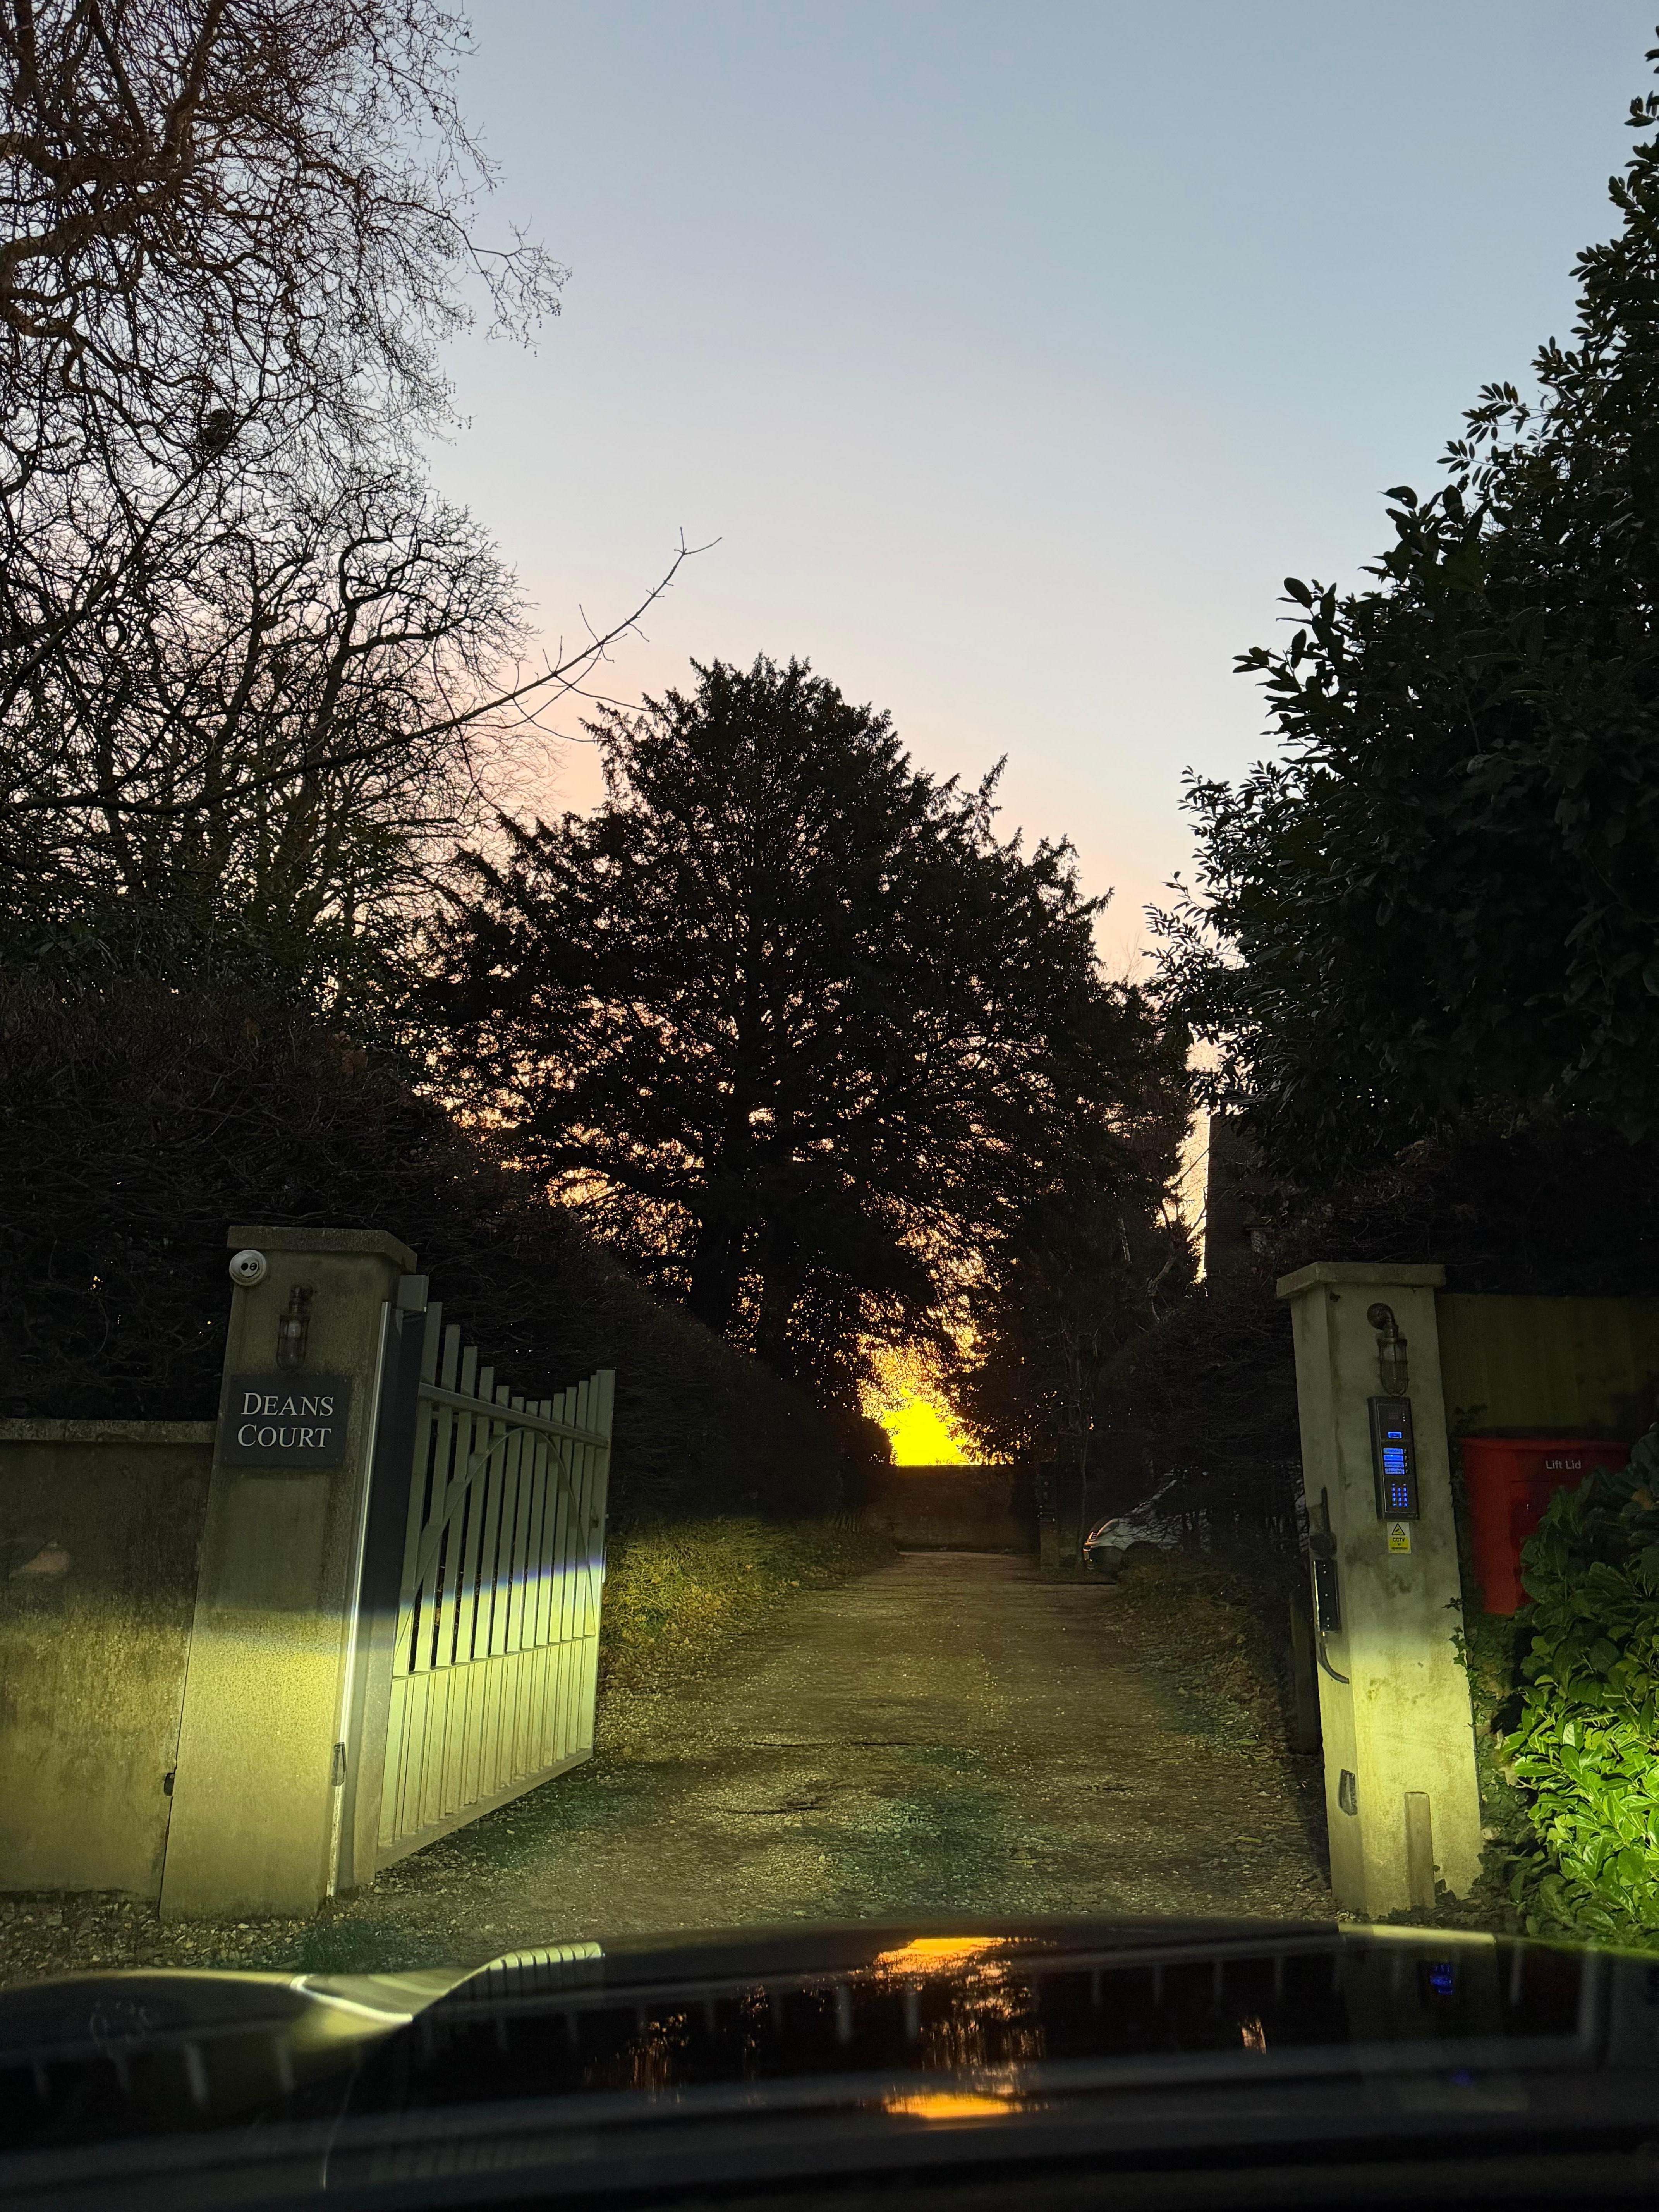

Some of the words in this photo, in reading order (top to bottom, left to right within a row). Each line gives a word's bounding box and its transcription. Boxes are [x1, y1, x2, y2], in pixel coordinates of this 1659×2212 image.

[241, 1392, 333, 1416] DEANS
[238, 1424, 331, 1447] COURT
[1546, 1460, 1562, 1469] Lift
[1565, 1460, 1581, 1469] Lid
